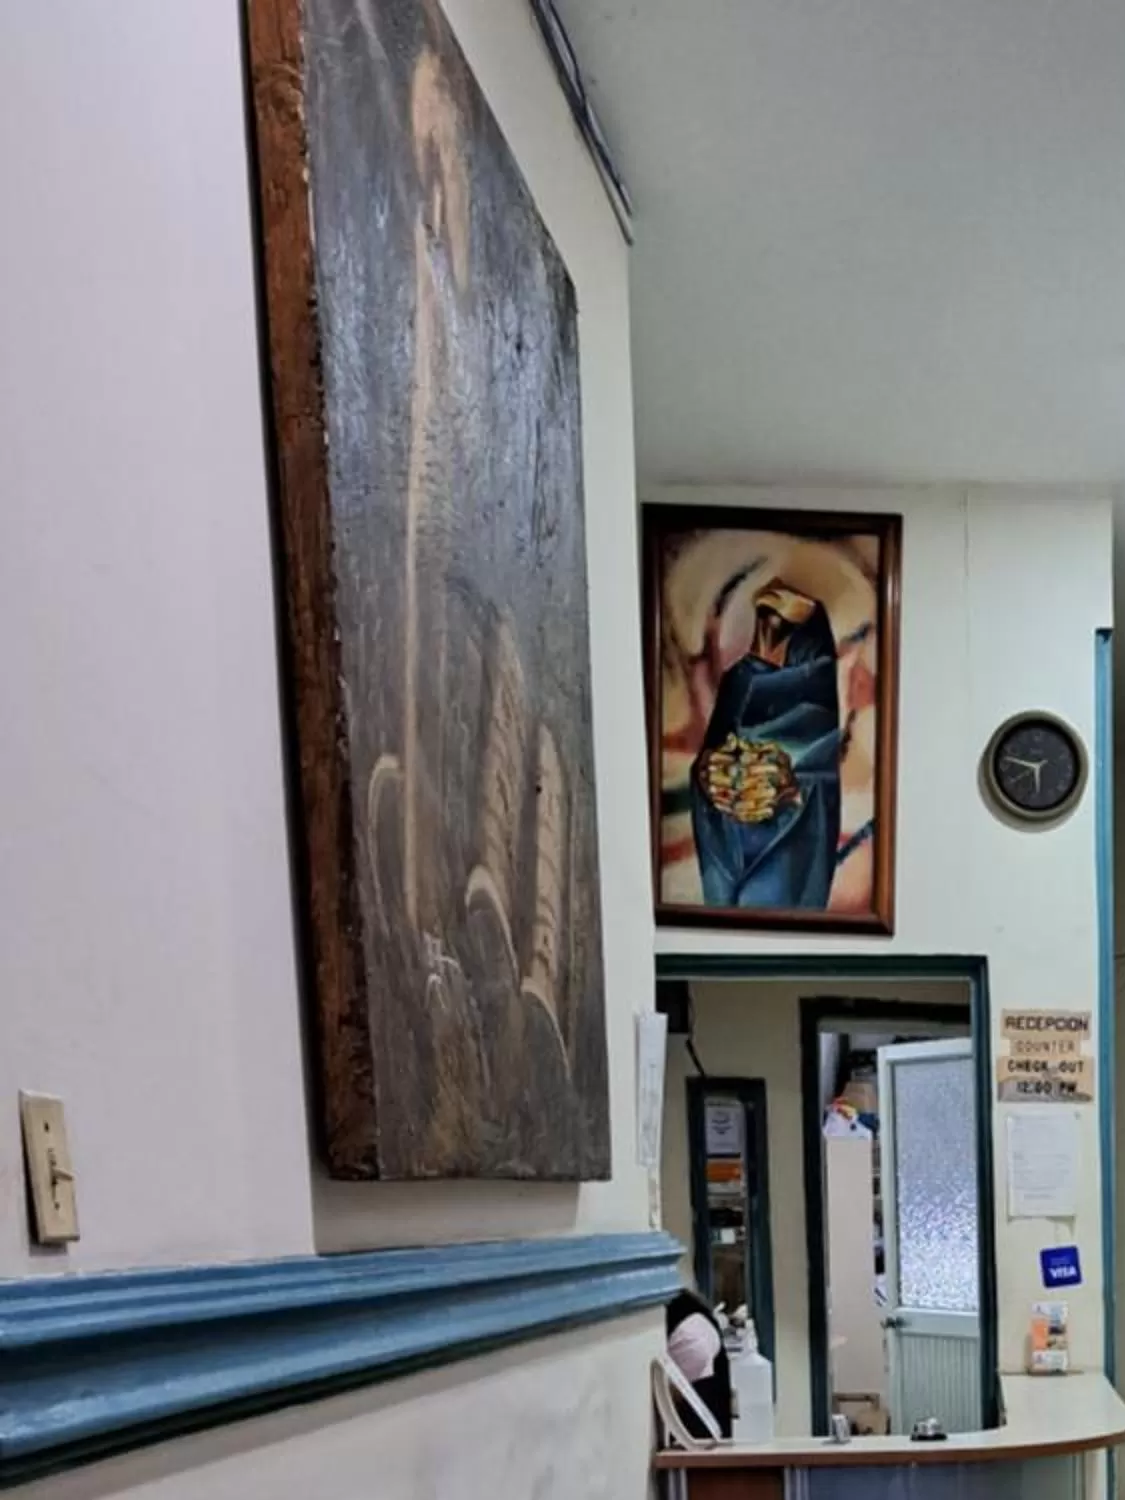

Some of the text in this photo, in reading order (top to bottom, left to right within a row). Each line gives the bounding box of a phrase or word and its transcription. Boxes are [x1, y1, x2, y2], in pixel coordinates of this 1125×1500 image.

[1007, 1059, 1084, 1073] CHECK OUT
[1048, 1266, 1077, 1279] VISA
